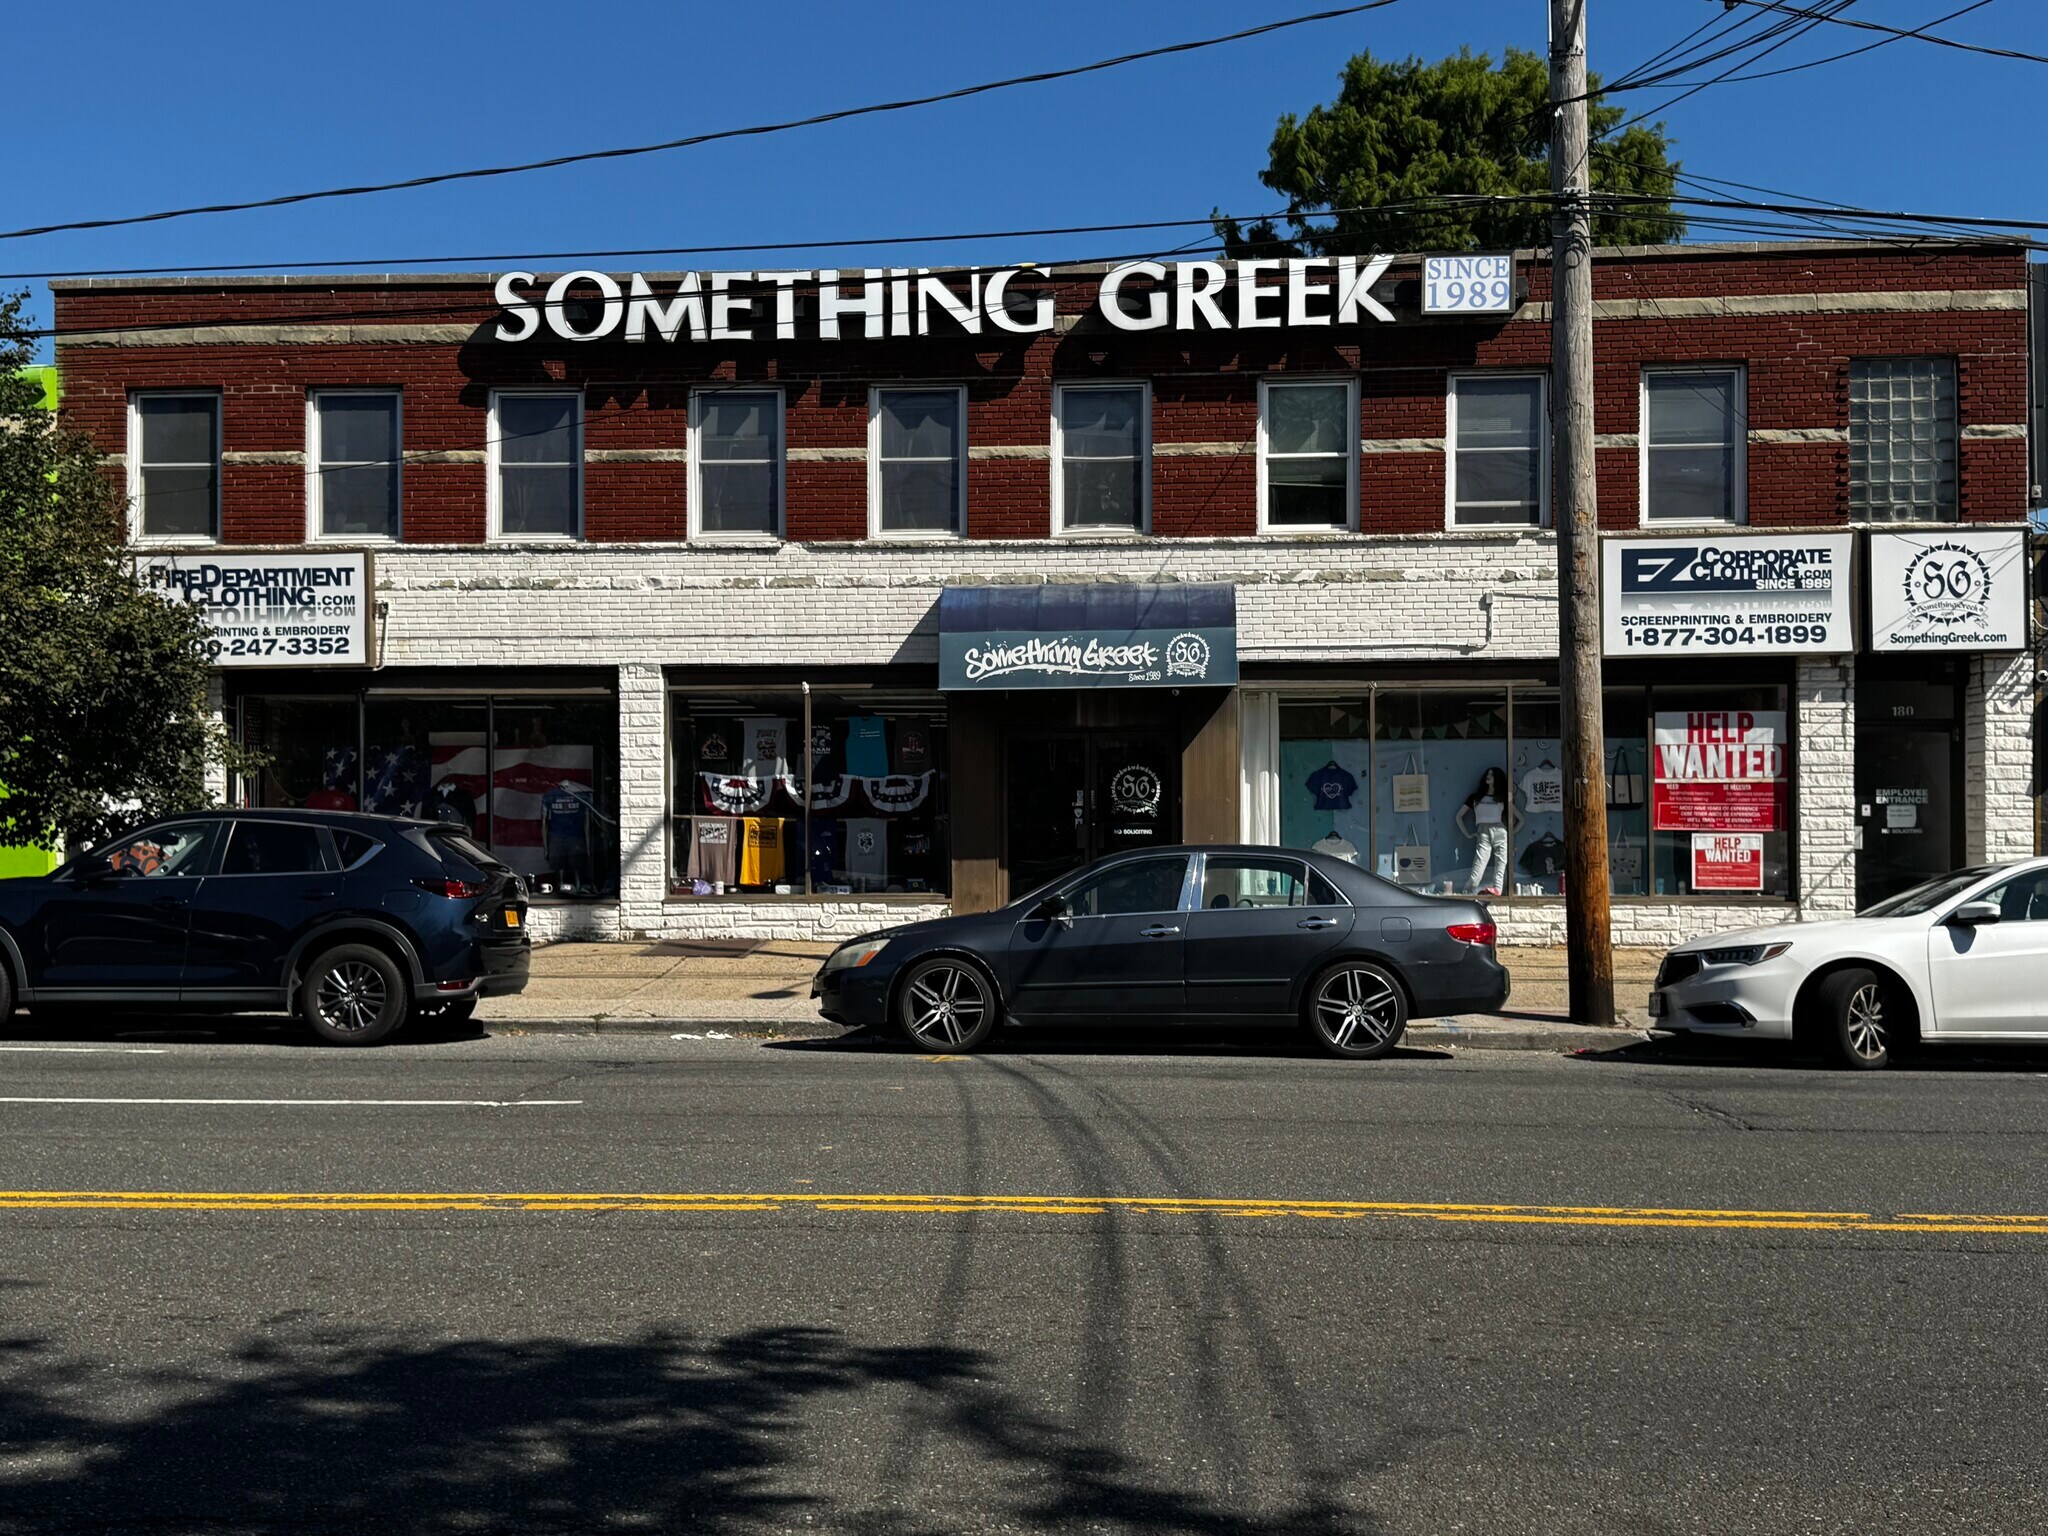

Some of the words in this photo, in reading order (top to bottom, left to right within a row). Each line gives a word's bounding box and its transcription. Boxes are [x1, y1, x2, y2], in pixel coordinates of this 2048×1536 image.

[1427, 256, 1509, 280] SINCE
[494, 265, 1054, 343] SOMETHING
[1099, 253, 1396, 331] GREEK
[1427, 281, 1510, 309] 1989
[1636, 549, 1698, 583] EZ
[1700, 547, 1832, 566] CORPORATE
[149, 565, 355, 588] FIREDEPARTMENT
[1690, 562, 1832, 582] CLOTHING.COM
[1923, 560, 1971, 599] SG
[1756, 578, 1796, 589] SINCE
[1801, 577, 1832, 589] 1989
[184, 586, 355, 607] CLOTHING.COM
[1621, 615, 1730, 626] SCREENPRINTING
[1735, 615, 1744, 624] &
[1749, 613, 1832, 624] EMBROIDERY
[262, 626, 271, 636] &
[275, 625, 350, 636] EMBROIDERY
[1625, 626, 1827, 646] 1-877-304-1899
[1890, 632, 2007, 645] SomethingGreek.com
[965, 637, 1081, 679] Something
[1082, 638, 1159, 670] Greek
[1175, 641, 1201, 663] SG
[1128, 672, 1146, 682] Since
[1145, 671, 1162, 682] 1989
[1892, 706, 1914, 717] 180
[1687, 713, 1753, 743] HELP
[1660, 744, 1782, 779] WANTED
[1121, 774, 1150, 799] SG
[1876, 796, 1928, 804] ENTRANCE
[1714, 837, 1741, 849] HELP
[1705, 849, 1751, 863] WANTED
